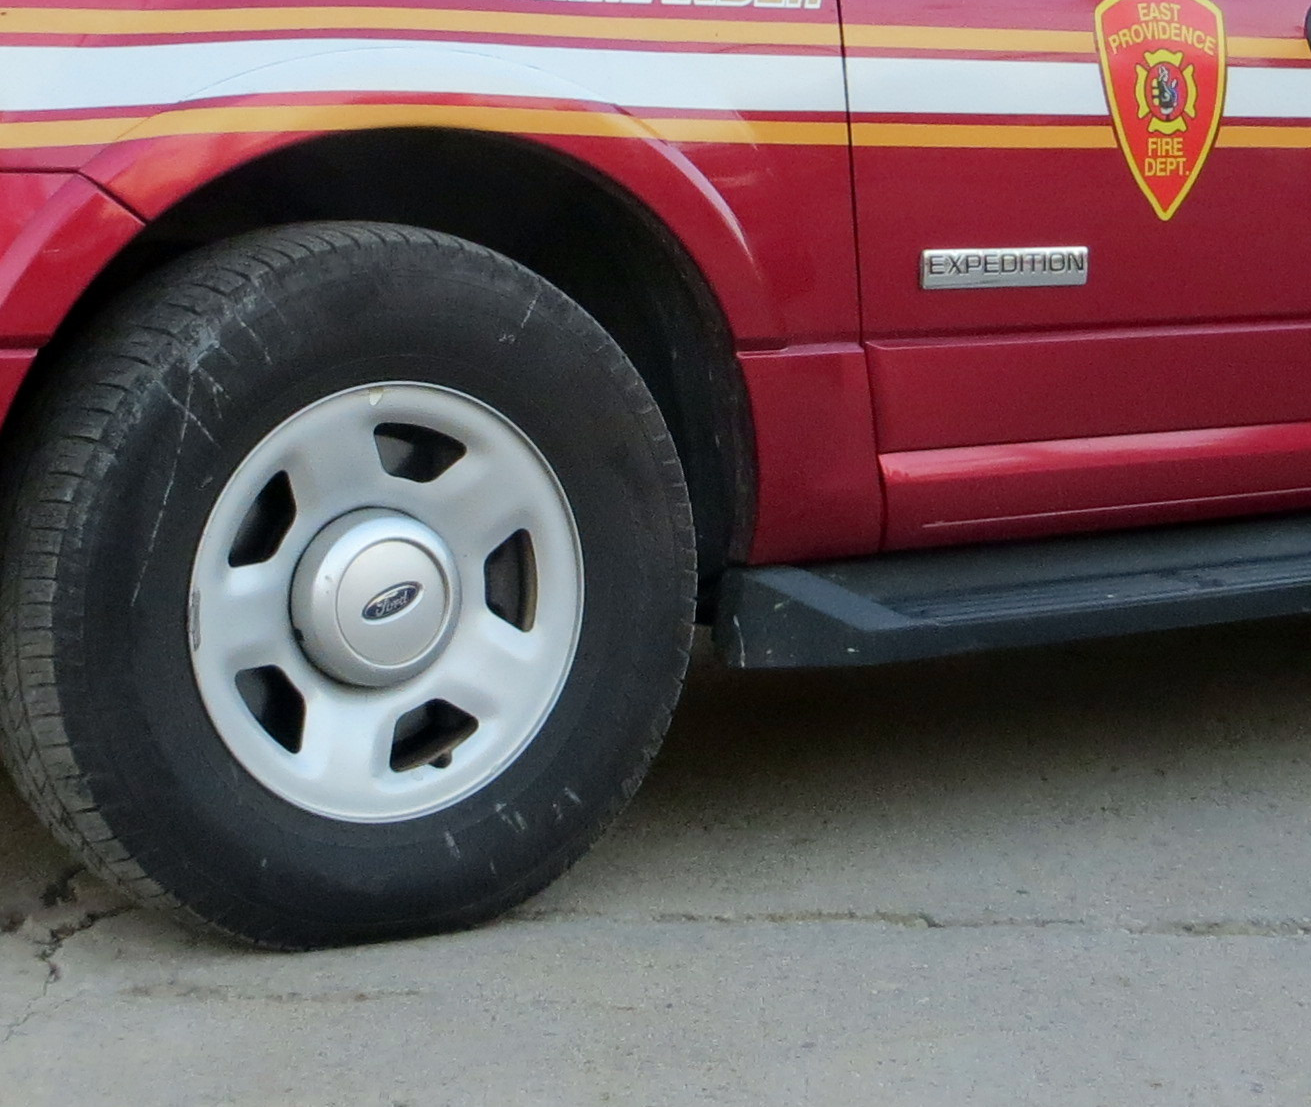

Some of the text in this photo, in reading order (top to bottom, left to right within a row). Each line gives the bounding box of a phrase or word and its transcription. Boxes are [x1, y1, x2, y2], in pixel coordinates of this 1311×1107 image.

[1137, 2, 1182, 21] EAST
[1108, 21, 1217, 55] PROVIDENCE
[1147, 137, 1184, 156] FIRE
[1144, 158, 1190, 176] DEPT.
[928, 252, 1085, 275] EXPEDITION
